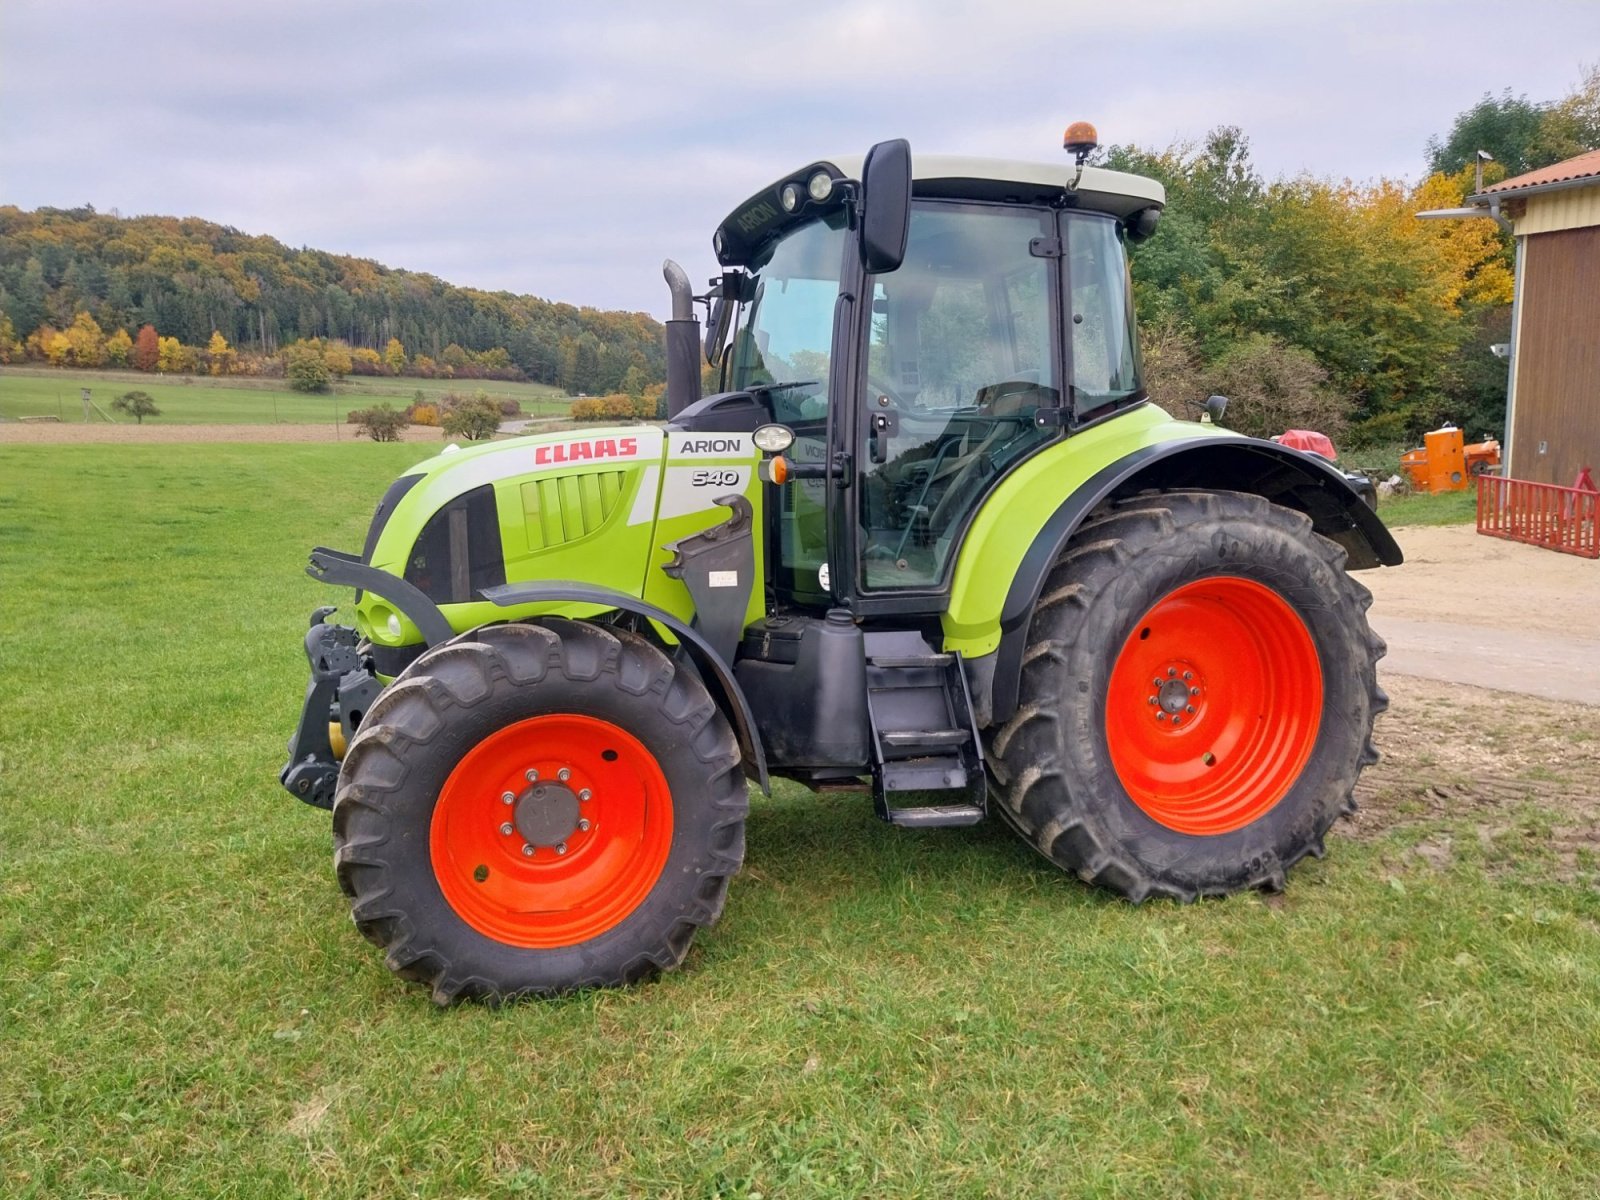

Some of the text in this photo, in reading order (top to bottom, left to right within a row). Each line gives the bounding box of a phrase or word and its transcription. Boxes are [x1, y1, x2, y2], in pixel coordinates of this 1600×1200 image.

[736, 200, 779, 232] ARION
[535, 438, 637, 465] CLAAS
[680, 439, 741, 454] ARION
[691, 470, 740, 487] 540
